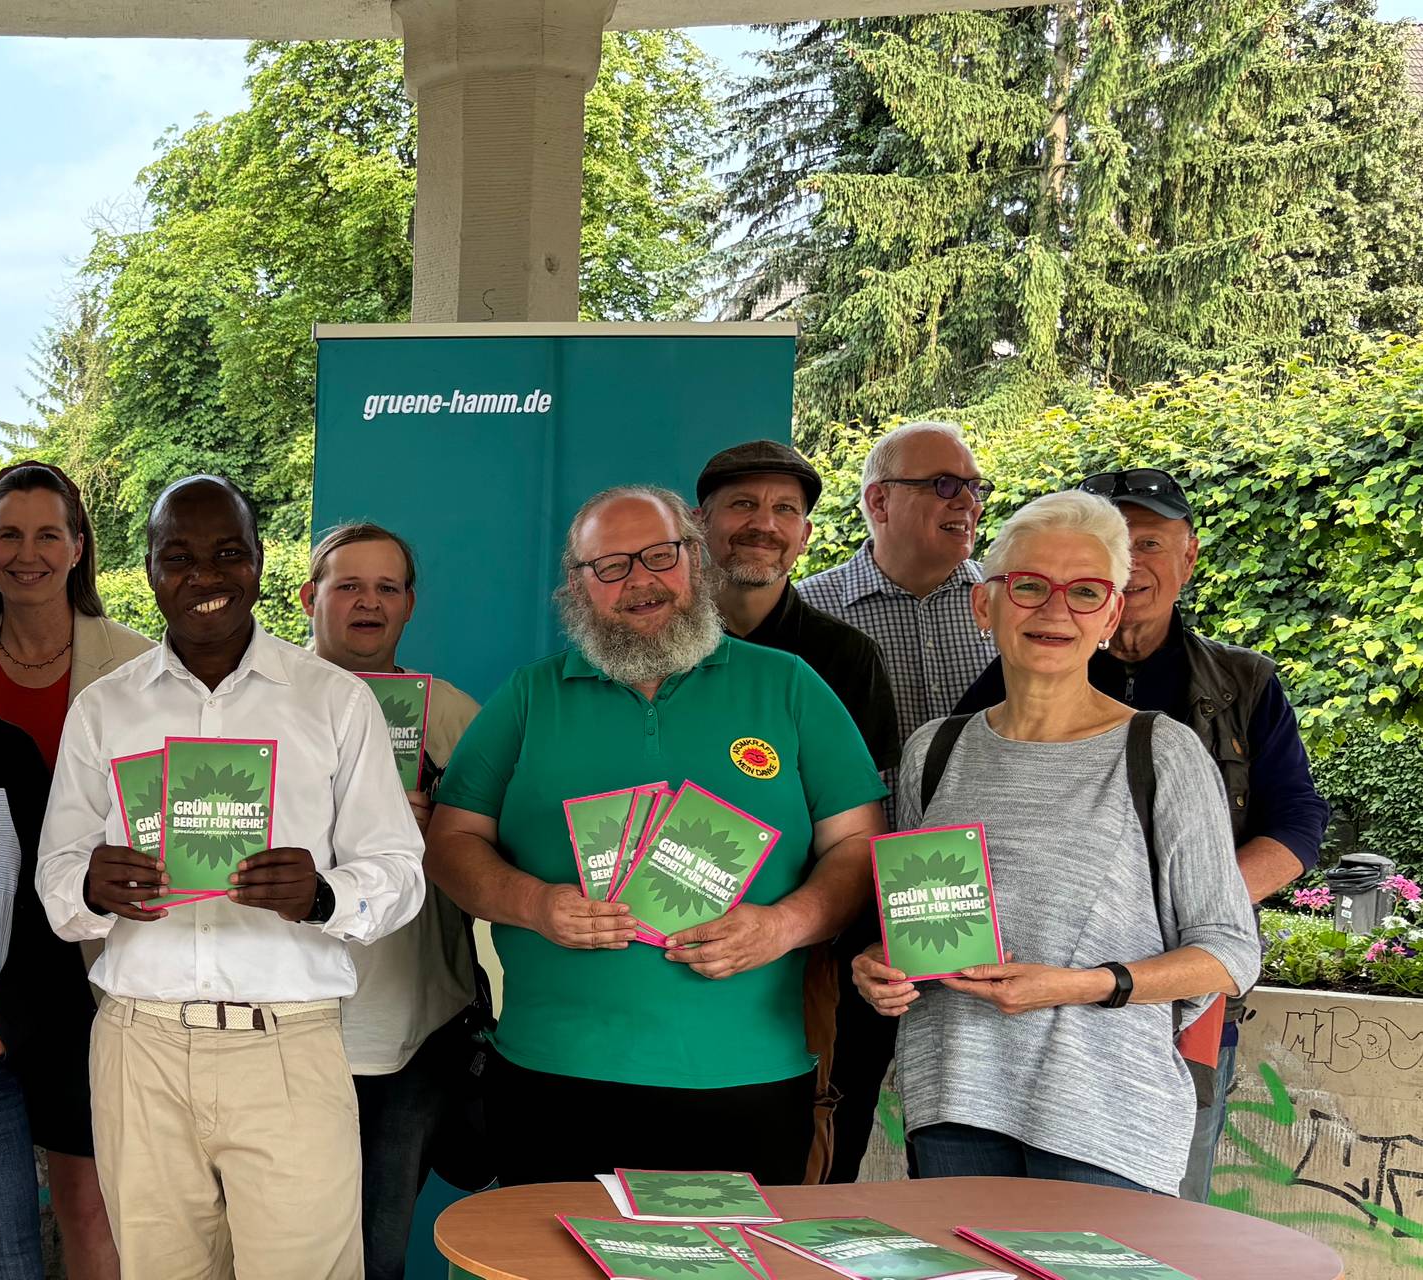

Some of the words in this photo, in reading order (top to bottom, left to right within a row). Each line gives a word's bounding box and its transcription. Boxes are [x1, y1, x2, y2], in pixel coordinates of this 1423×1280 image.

[363, 389, 552, 421] gruene-hamm.de
[387, 726, 418, 739] IRKT.
[392, 740, 417, 749] MEHR!
[173, 799, 212, 816] GRÜN
[216, 801, 265, 817] WIRKT.
[136, 812, 162, 833] GRÜ
[173, 817, 208, 828] BEREIT
[210, 816, 230, 829] FÜR
[232, 818, 264, 829] MEHR!
[658, 838, 696, 866] GRÜN
[696, 856, 737, 891] WIRKT.
[651, 850, 685, 873] BEREIT
[684, 865, 703, 885] FÜR
[701, 879, 733, 901] MEHR!
[888, 887, 929, 906] GRÜN
[930, 884, 984, 901] WIRKT.
[890, 904, 926, 919] BEREIT
[928, 900, 950, 914] FÜR
[951, 898, 986, 912] MEHR!
